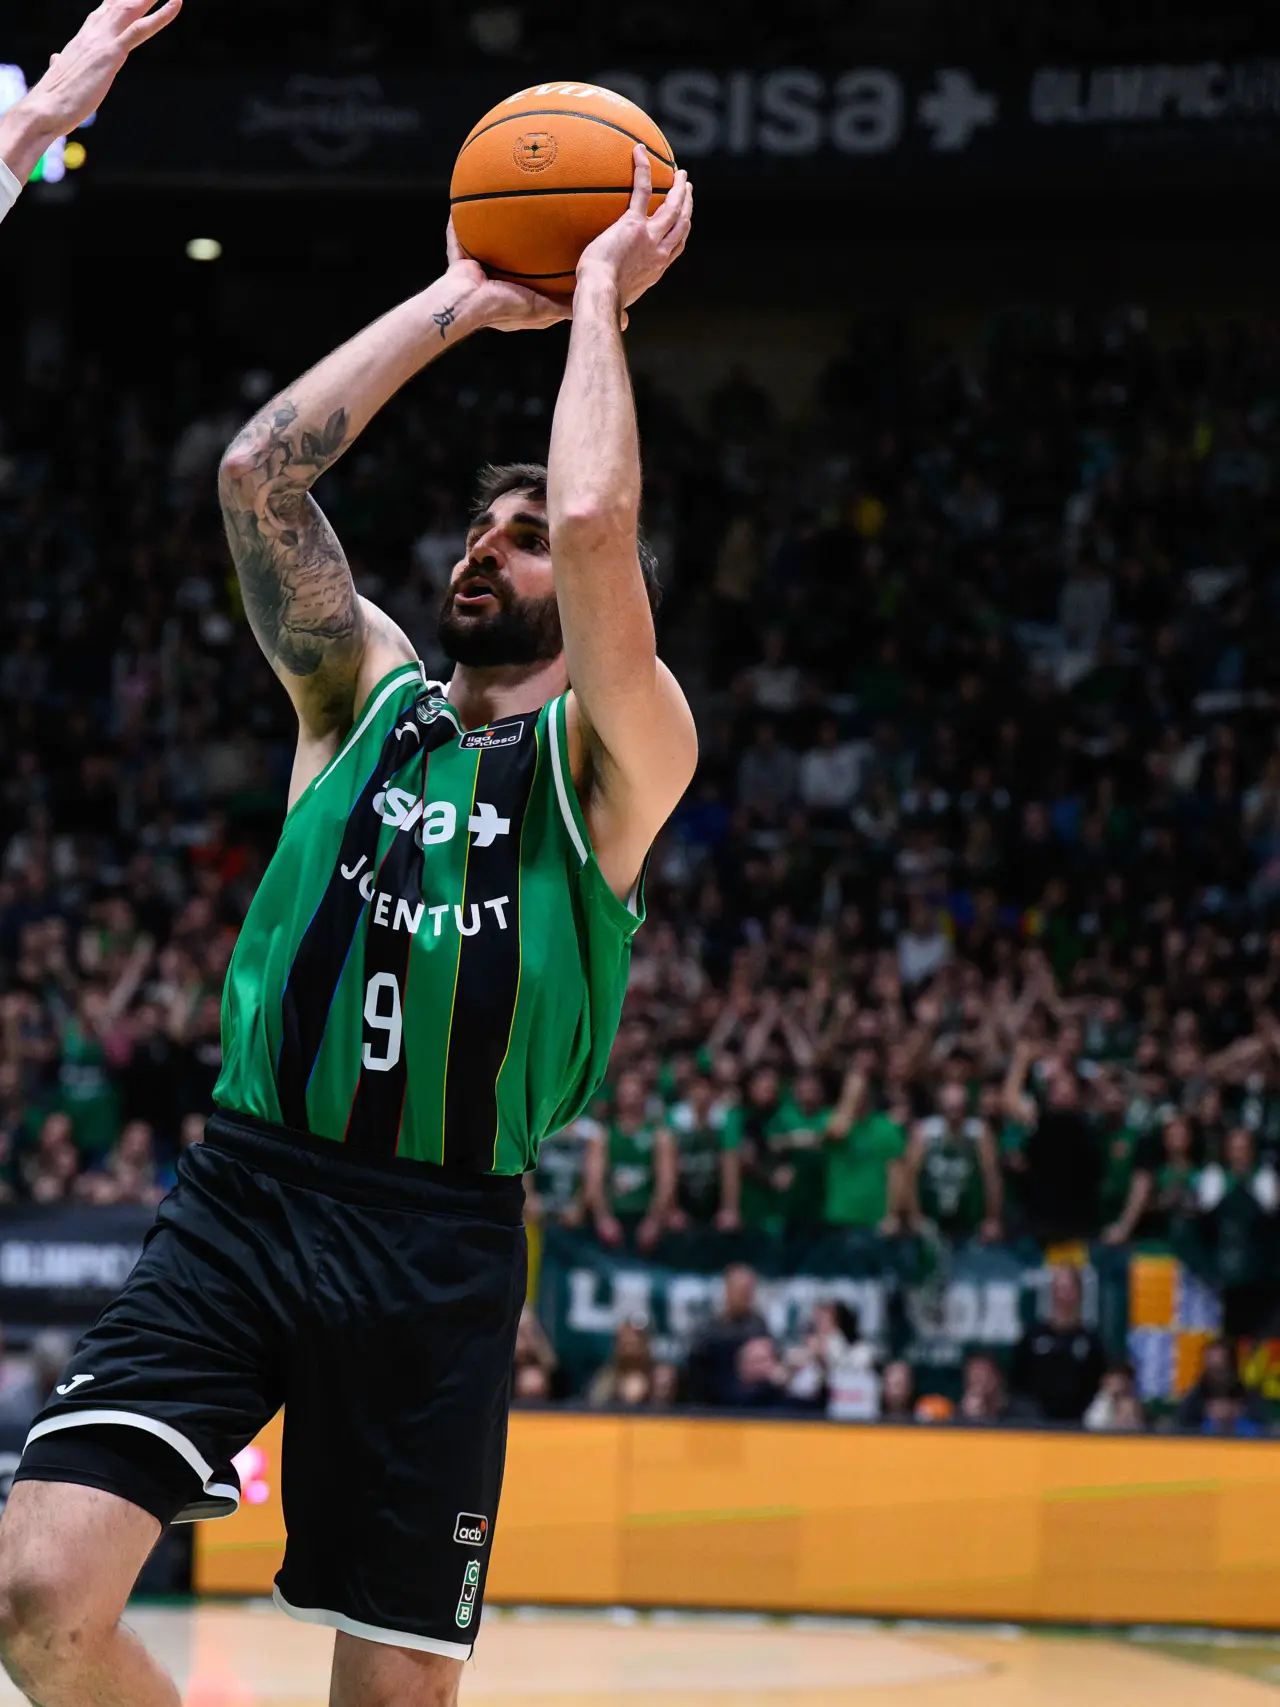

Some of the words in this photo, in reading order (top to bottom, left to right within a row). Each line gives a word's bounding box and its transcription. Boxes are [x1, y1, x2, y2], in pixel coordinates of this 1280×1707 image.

[340, 854, 510, 937] JOENTUT
[361, 971, 403, 1072] 9
[459, 1527, 482, 1541] acb
